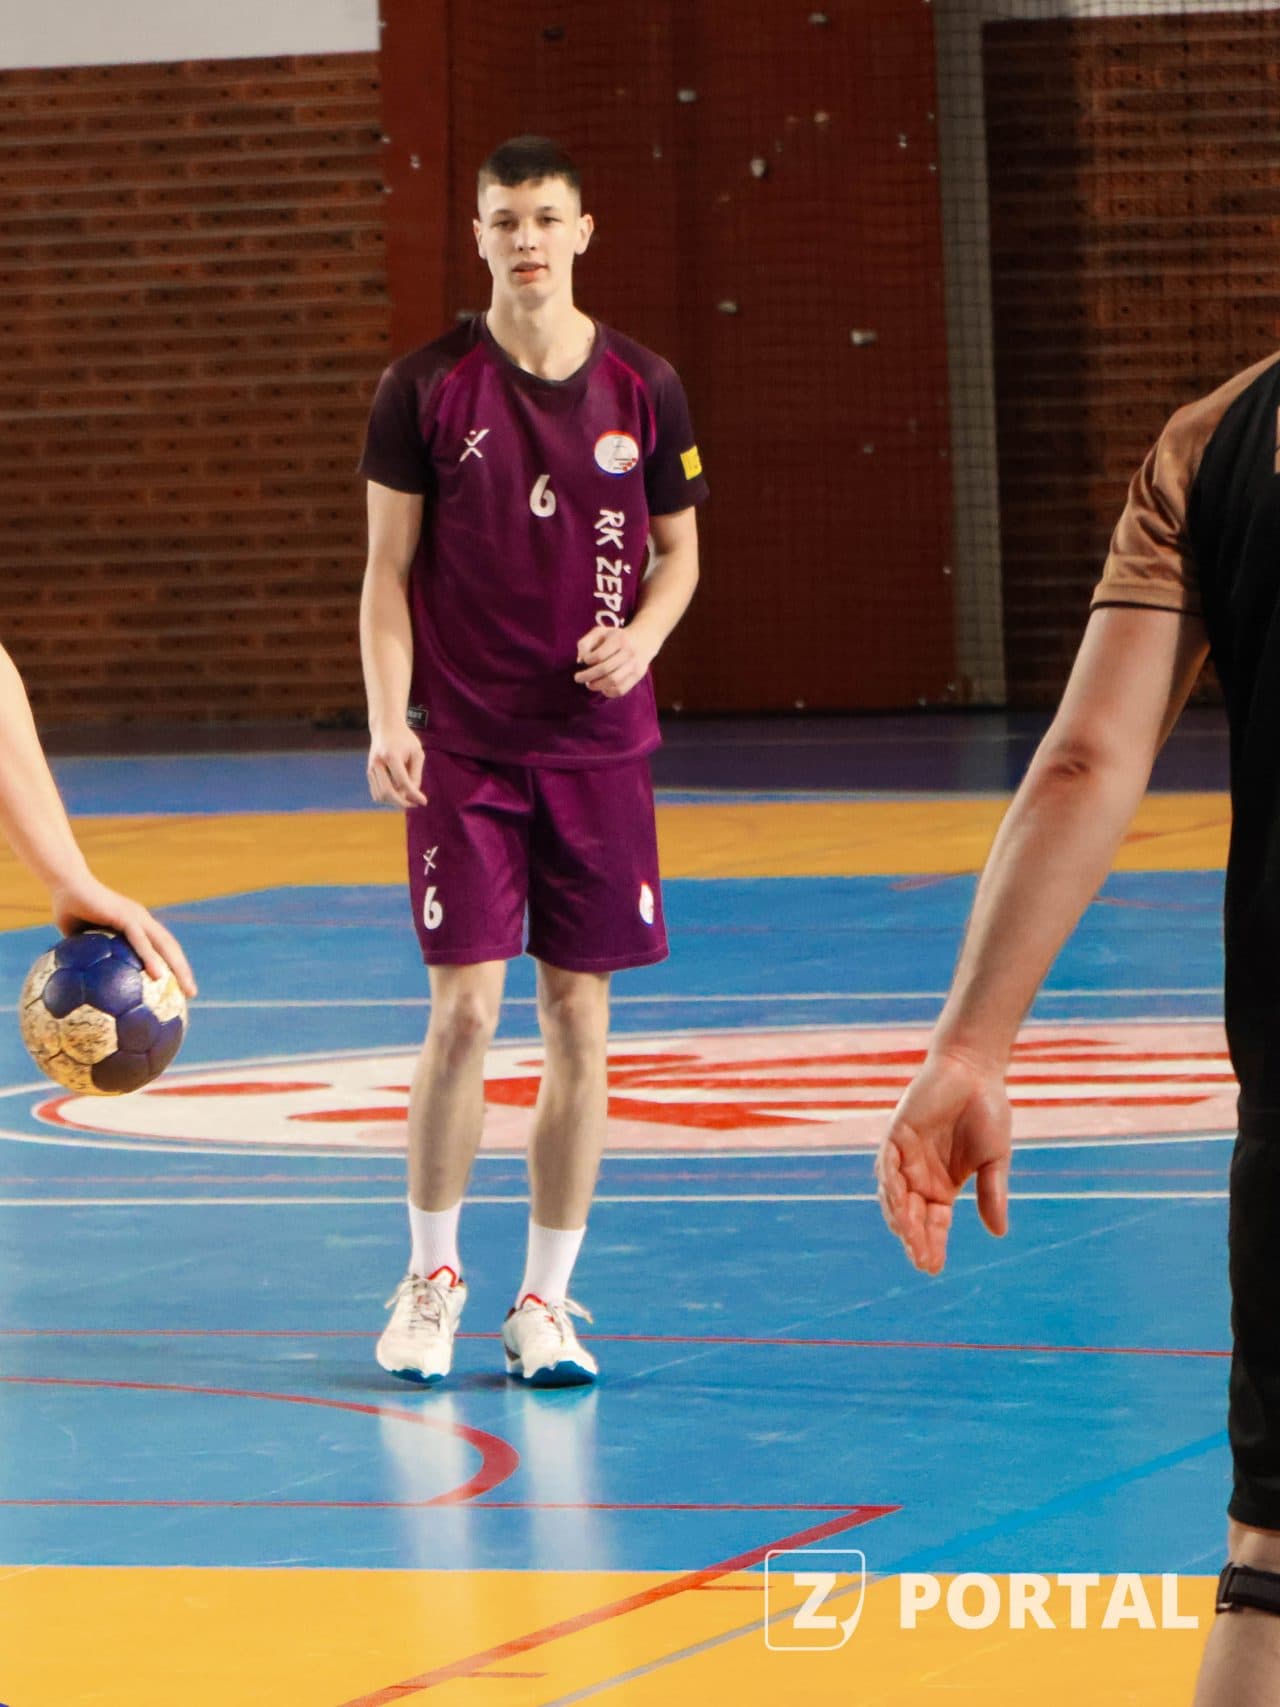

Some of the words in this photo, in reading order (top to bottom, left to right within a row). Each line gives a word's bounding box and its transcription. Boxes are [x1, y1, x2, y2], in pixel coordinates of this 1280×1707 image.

[529, 474, 557, 518] 6
[594, 509, 625, 549] RK
[422, 886, 444, 930] 6
